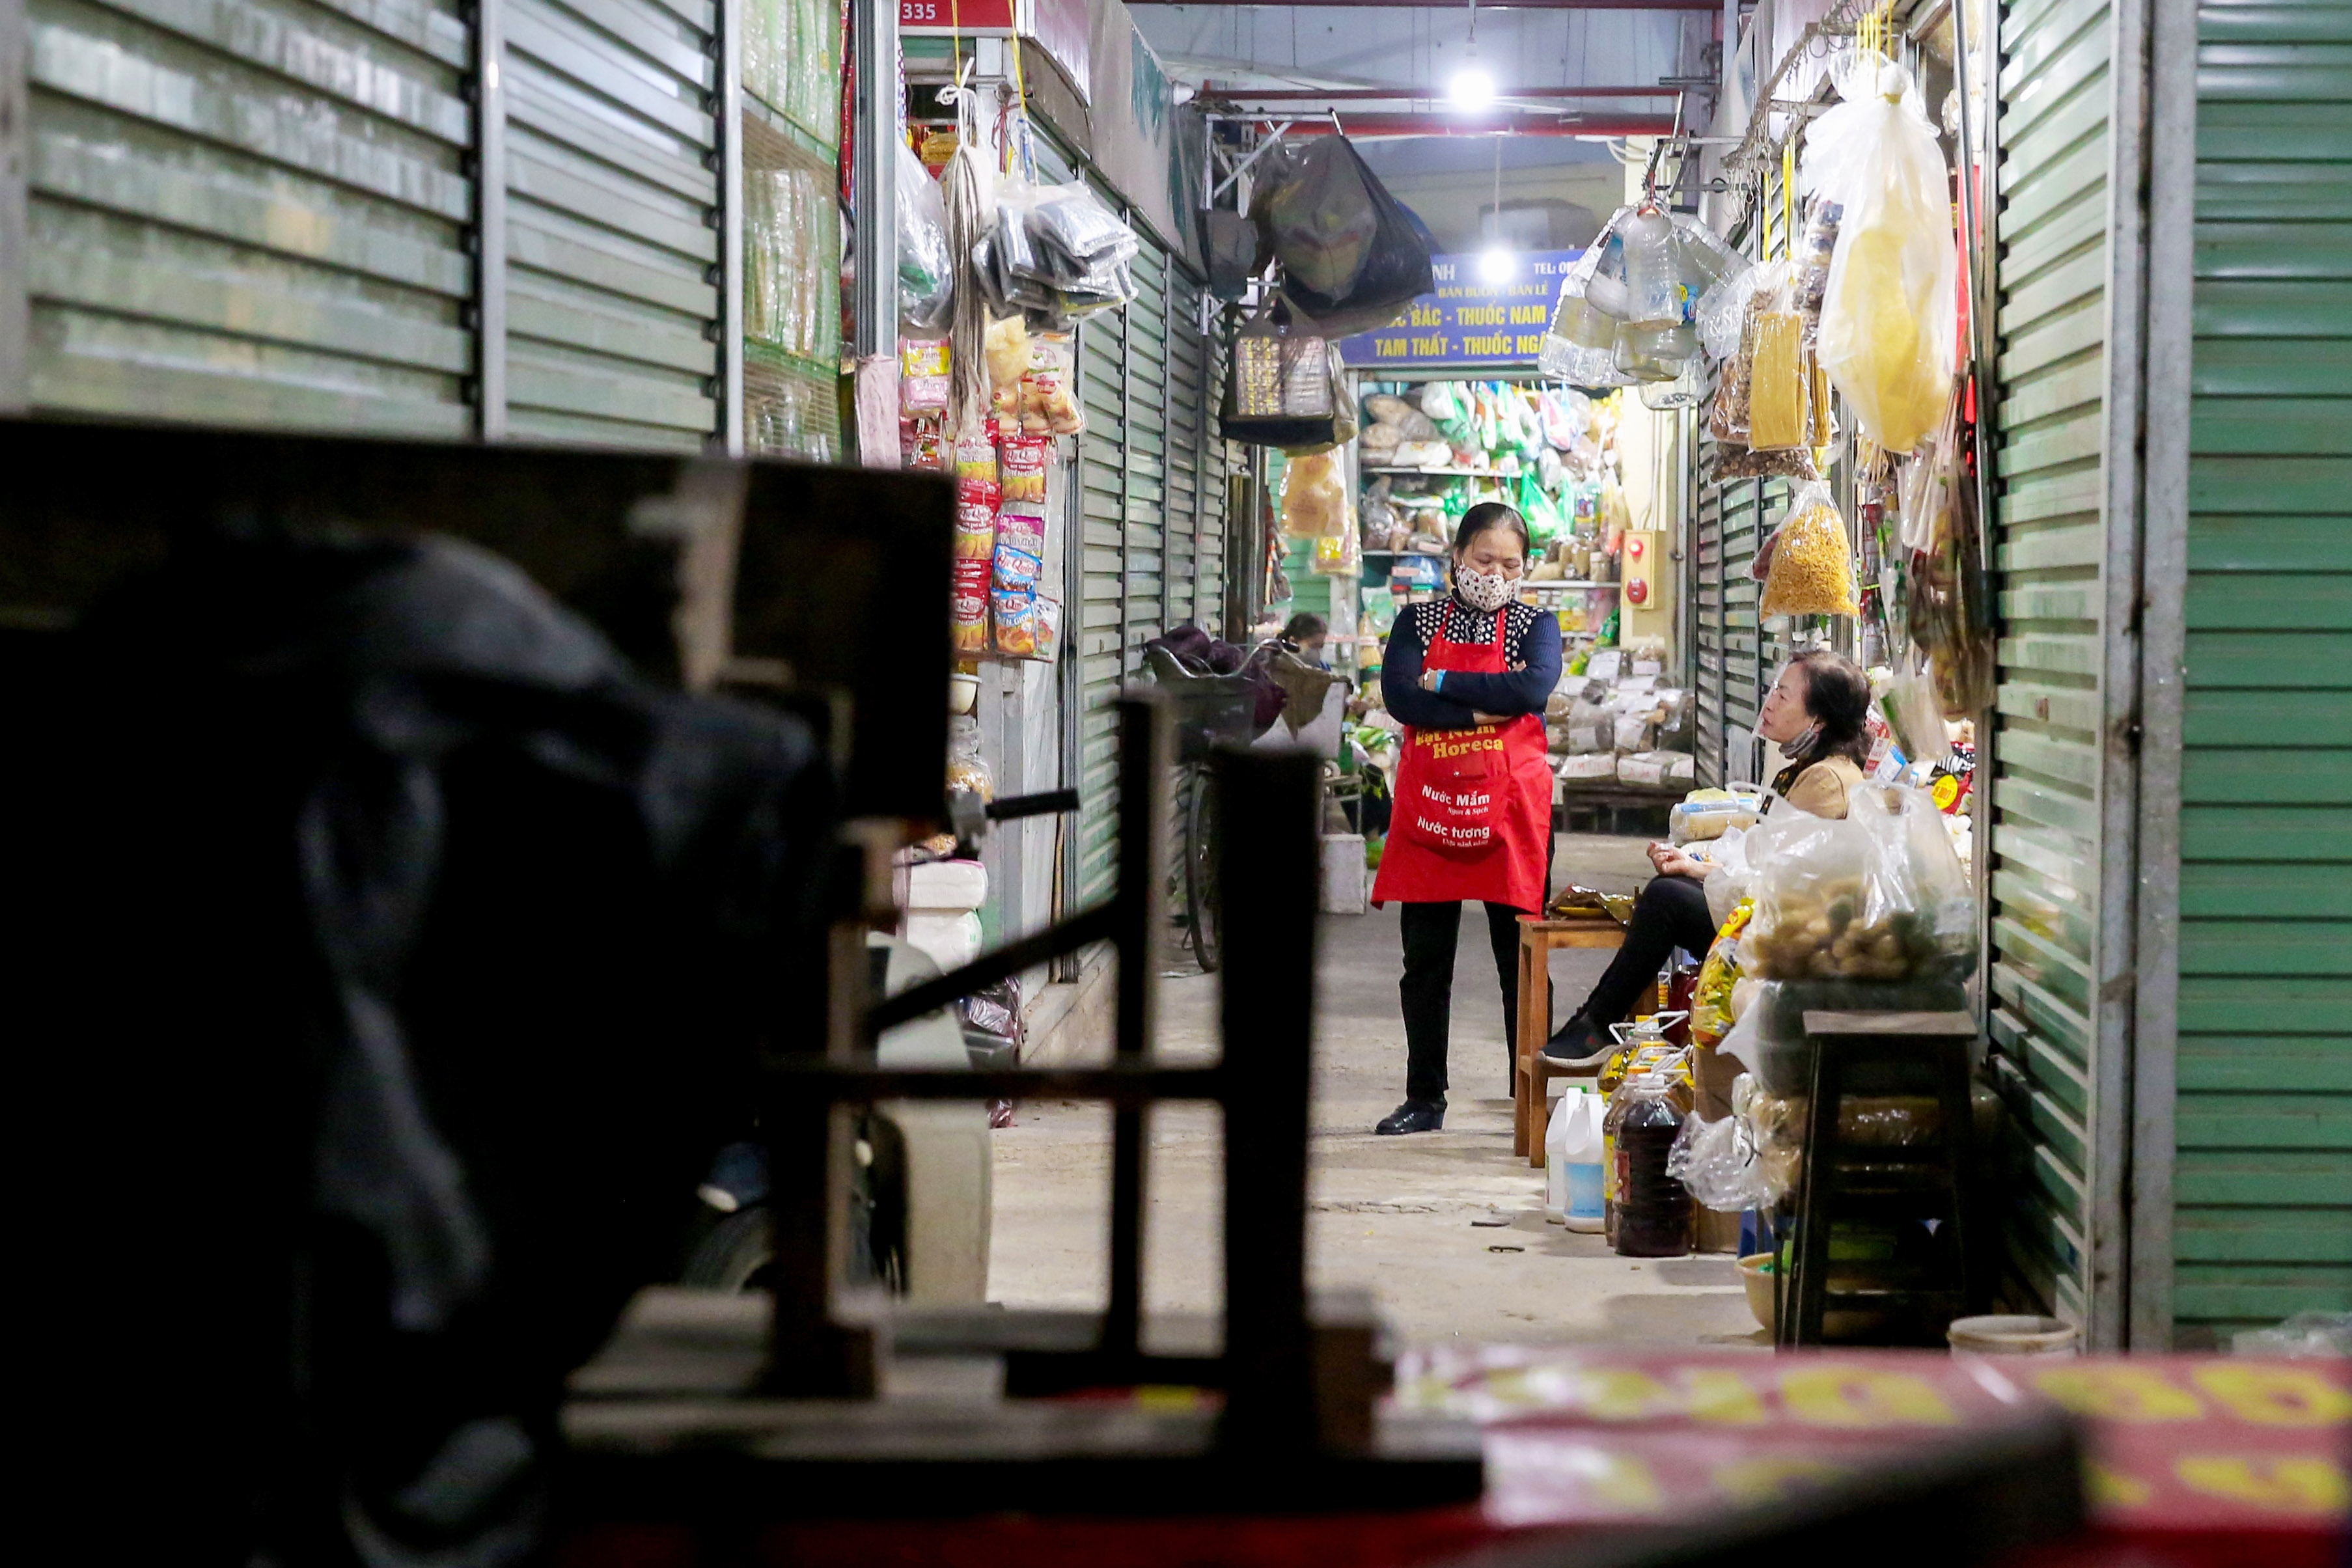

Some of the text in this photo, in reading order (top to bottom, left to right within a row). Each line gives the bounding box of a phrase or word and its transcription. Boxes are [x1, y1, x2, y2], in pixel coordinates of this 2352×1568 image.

[902, 3, 936, 20] 335
[1432, 264, 1455, 281] NH
[1456, 300, 1506, 325] THUỐC
[1510, 305, 1547, 325] NAM
[1375, 338, 1407, 357] TAM
[1411, 331, 1449, 356] THẤT
[1463, 329, 1513, 355] THUỐC
[1433, 738, 1504, 760] Horeca
[1422, 784, 1490, 806] Nước Mắm
[1472, 805, 1489, 816] Sạch
[1417, 815, 1490, 839] Nước tương
